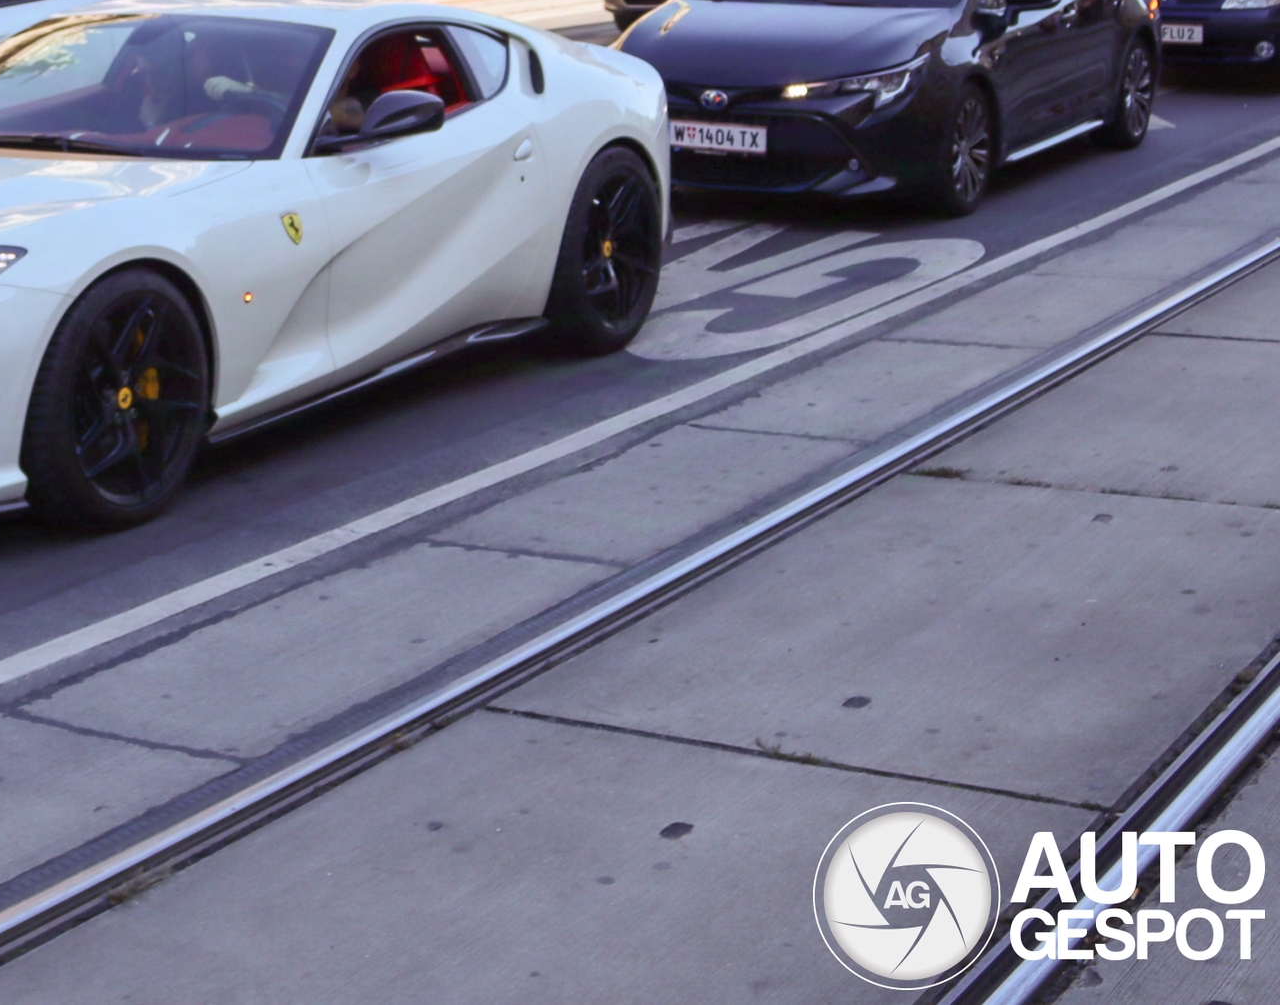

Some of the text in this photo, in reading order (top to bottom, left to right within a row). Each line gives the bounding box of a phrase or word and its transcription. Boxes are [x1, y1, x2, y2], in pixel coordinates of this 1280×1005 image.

[674, 125, 760, 148] W 1404 TX
